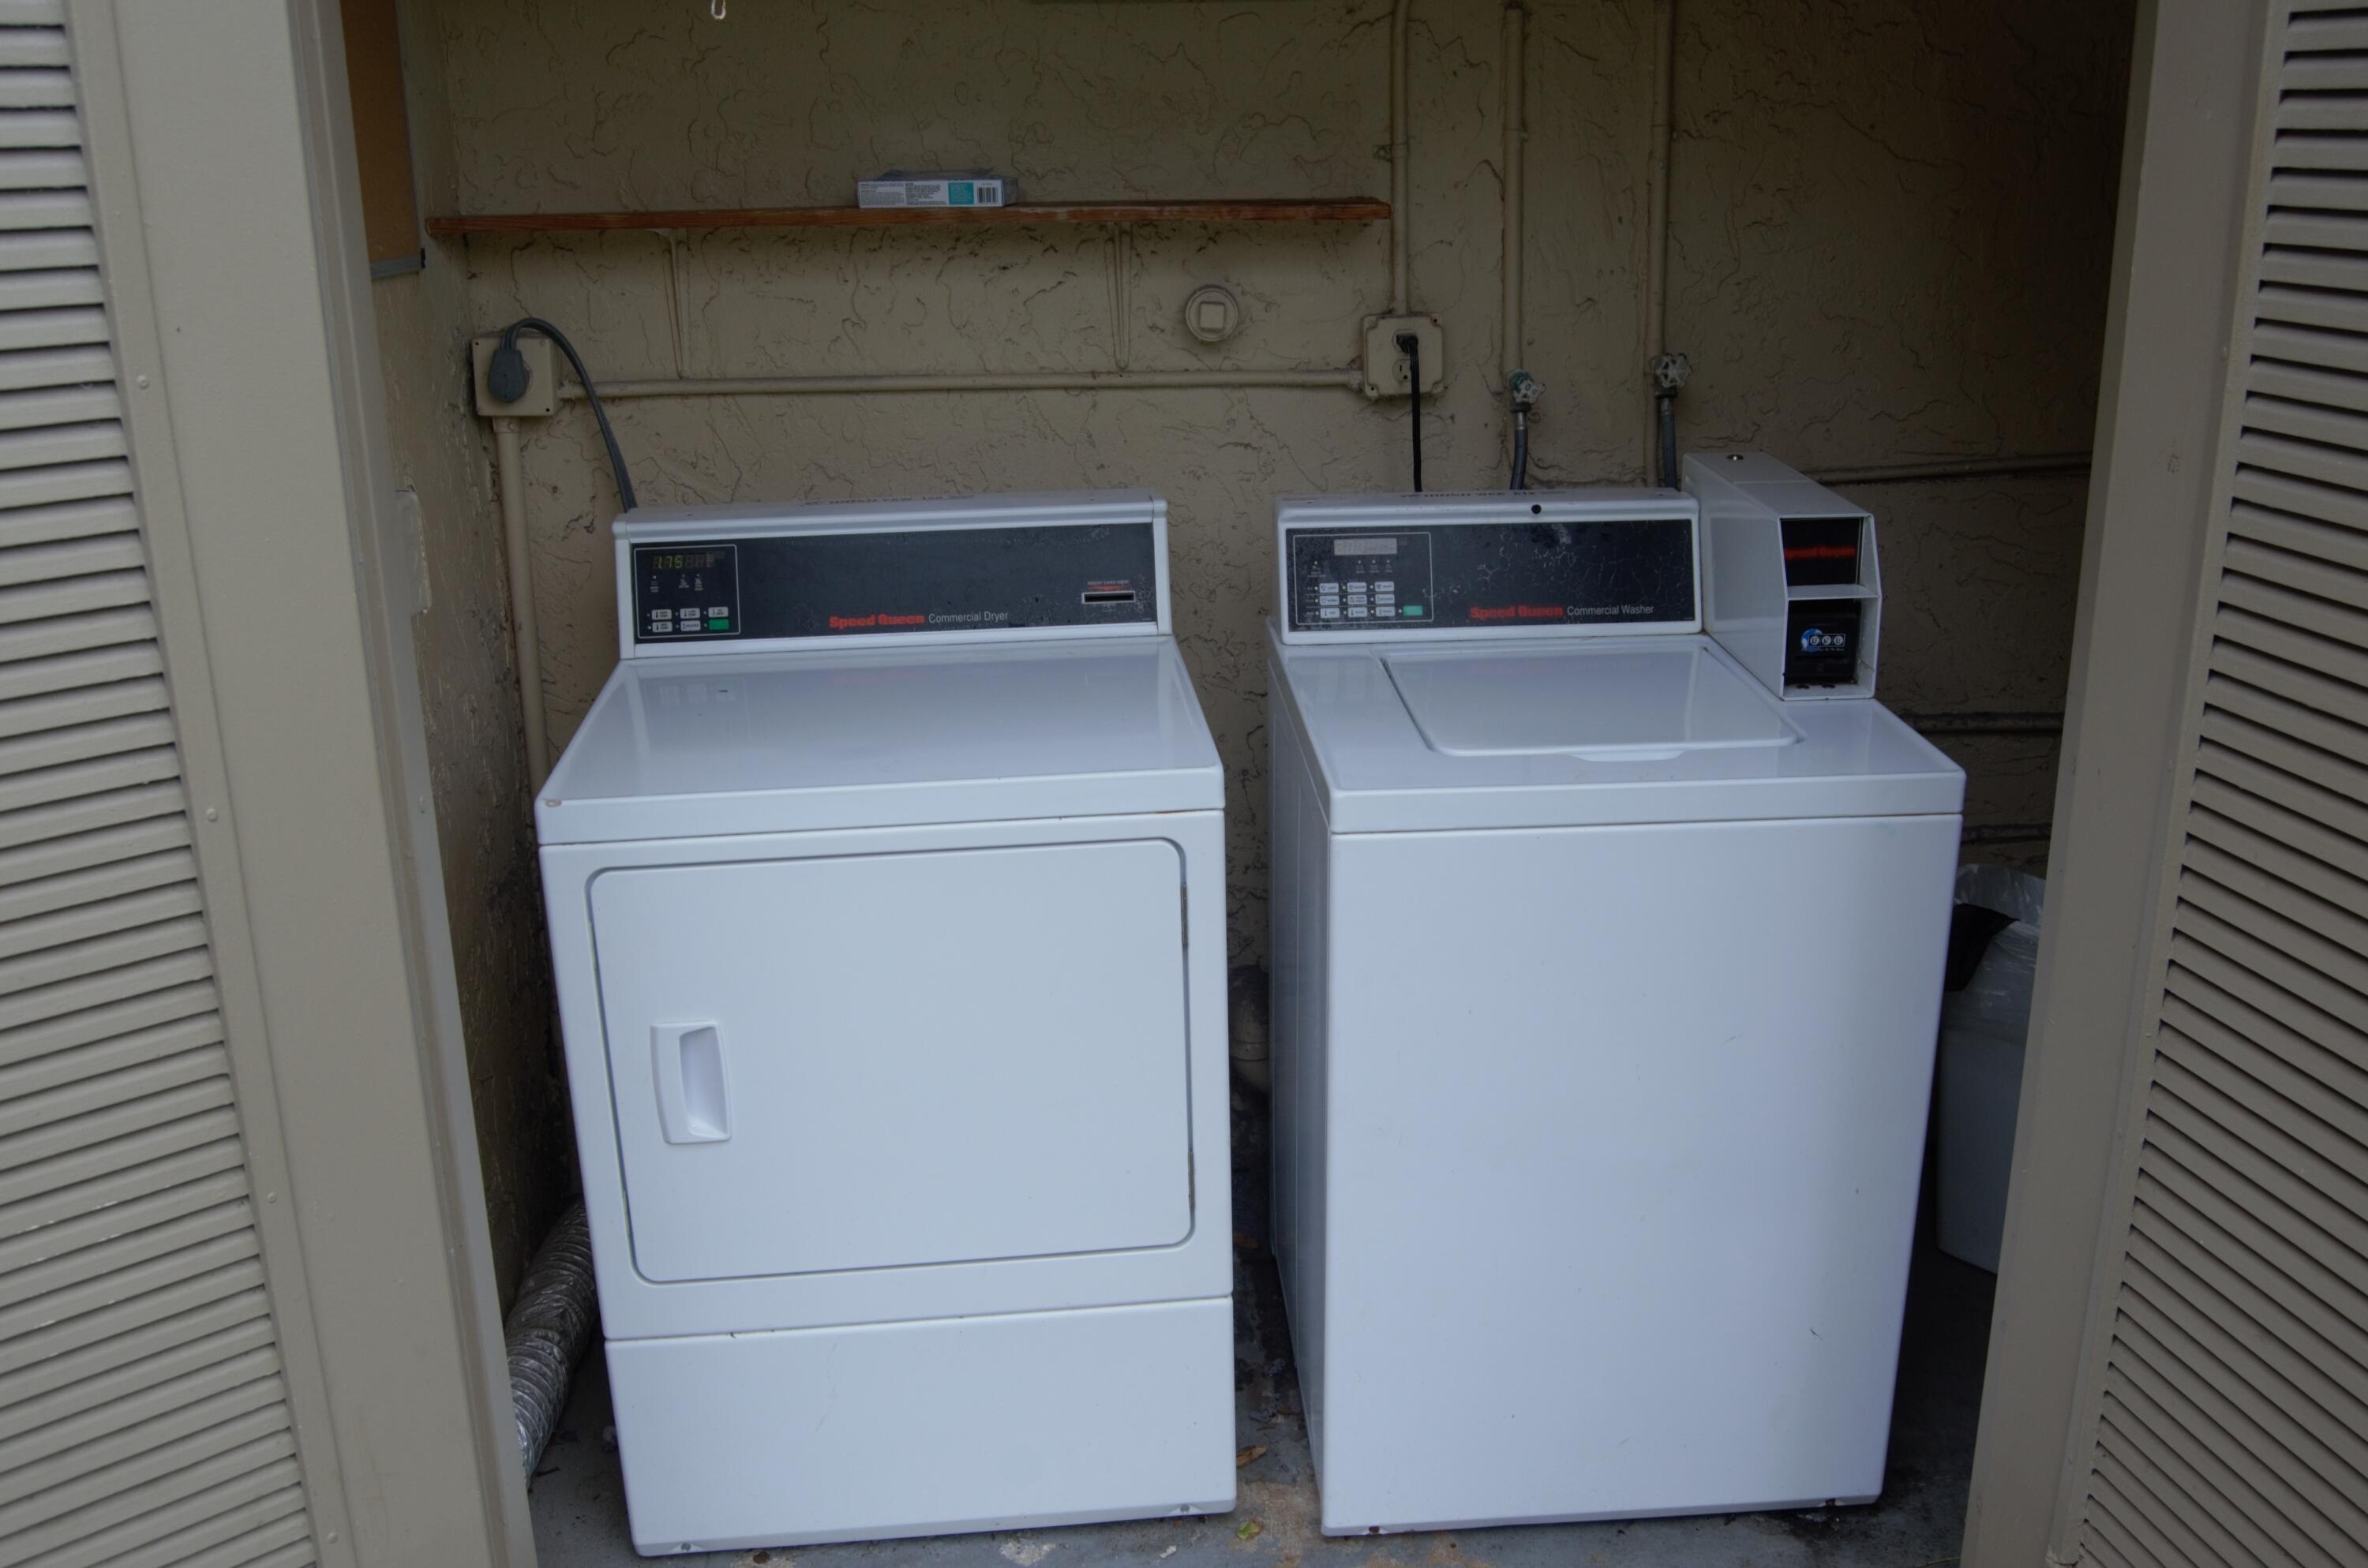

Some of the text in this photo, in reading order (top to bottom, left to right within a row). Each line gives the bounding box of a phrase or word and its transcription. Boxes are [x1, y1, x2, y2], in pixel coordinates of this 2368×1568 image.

[1567, 605, 1619, 616] Commercial
[1621, 605, 1654, 615] Washer
[830, 612, 1009, 629] Speed Queen Commercial Dryer
